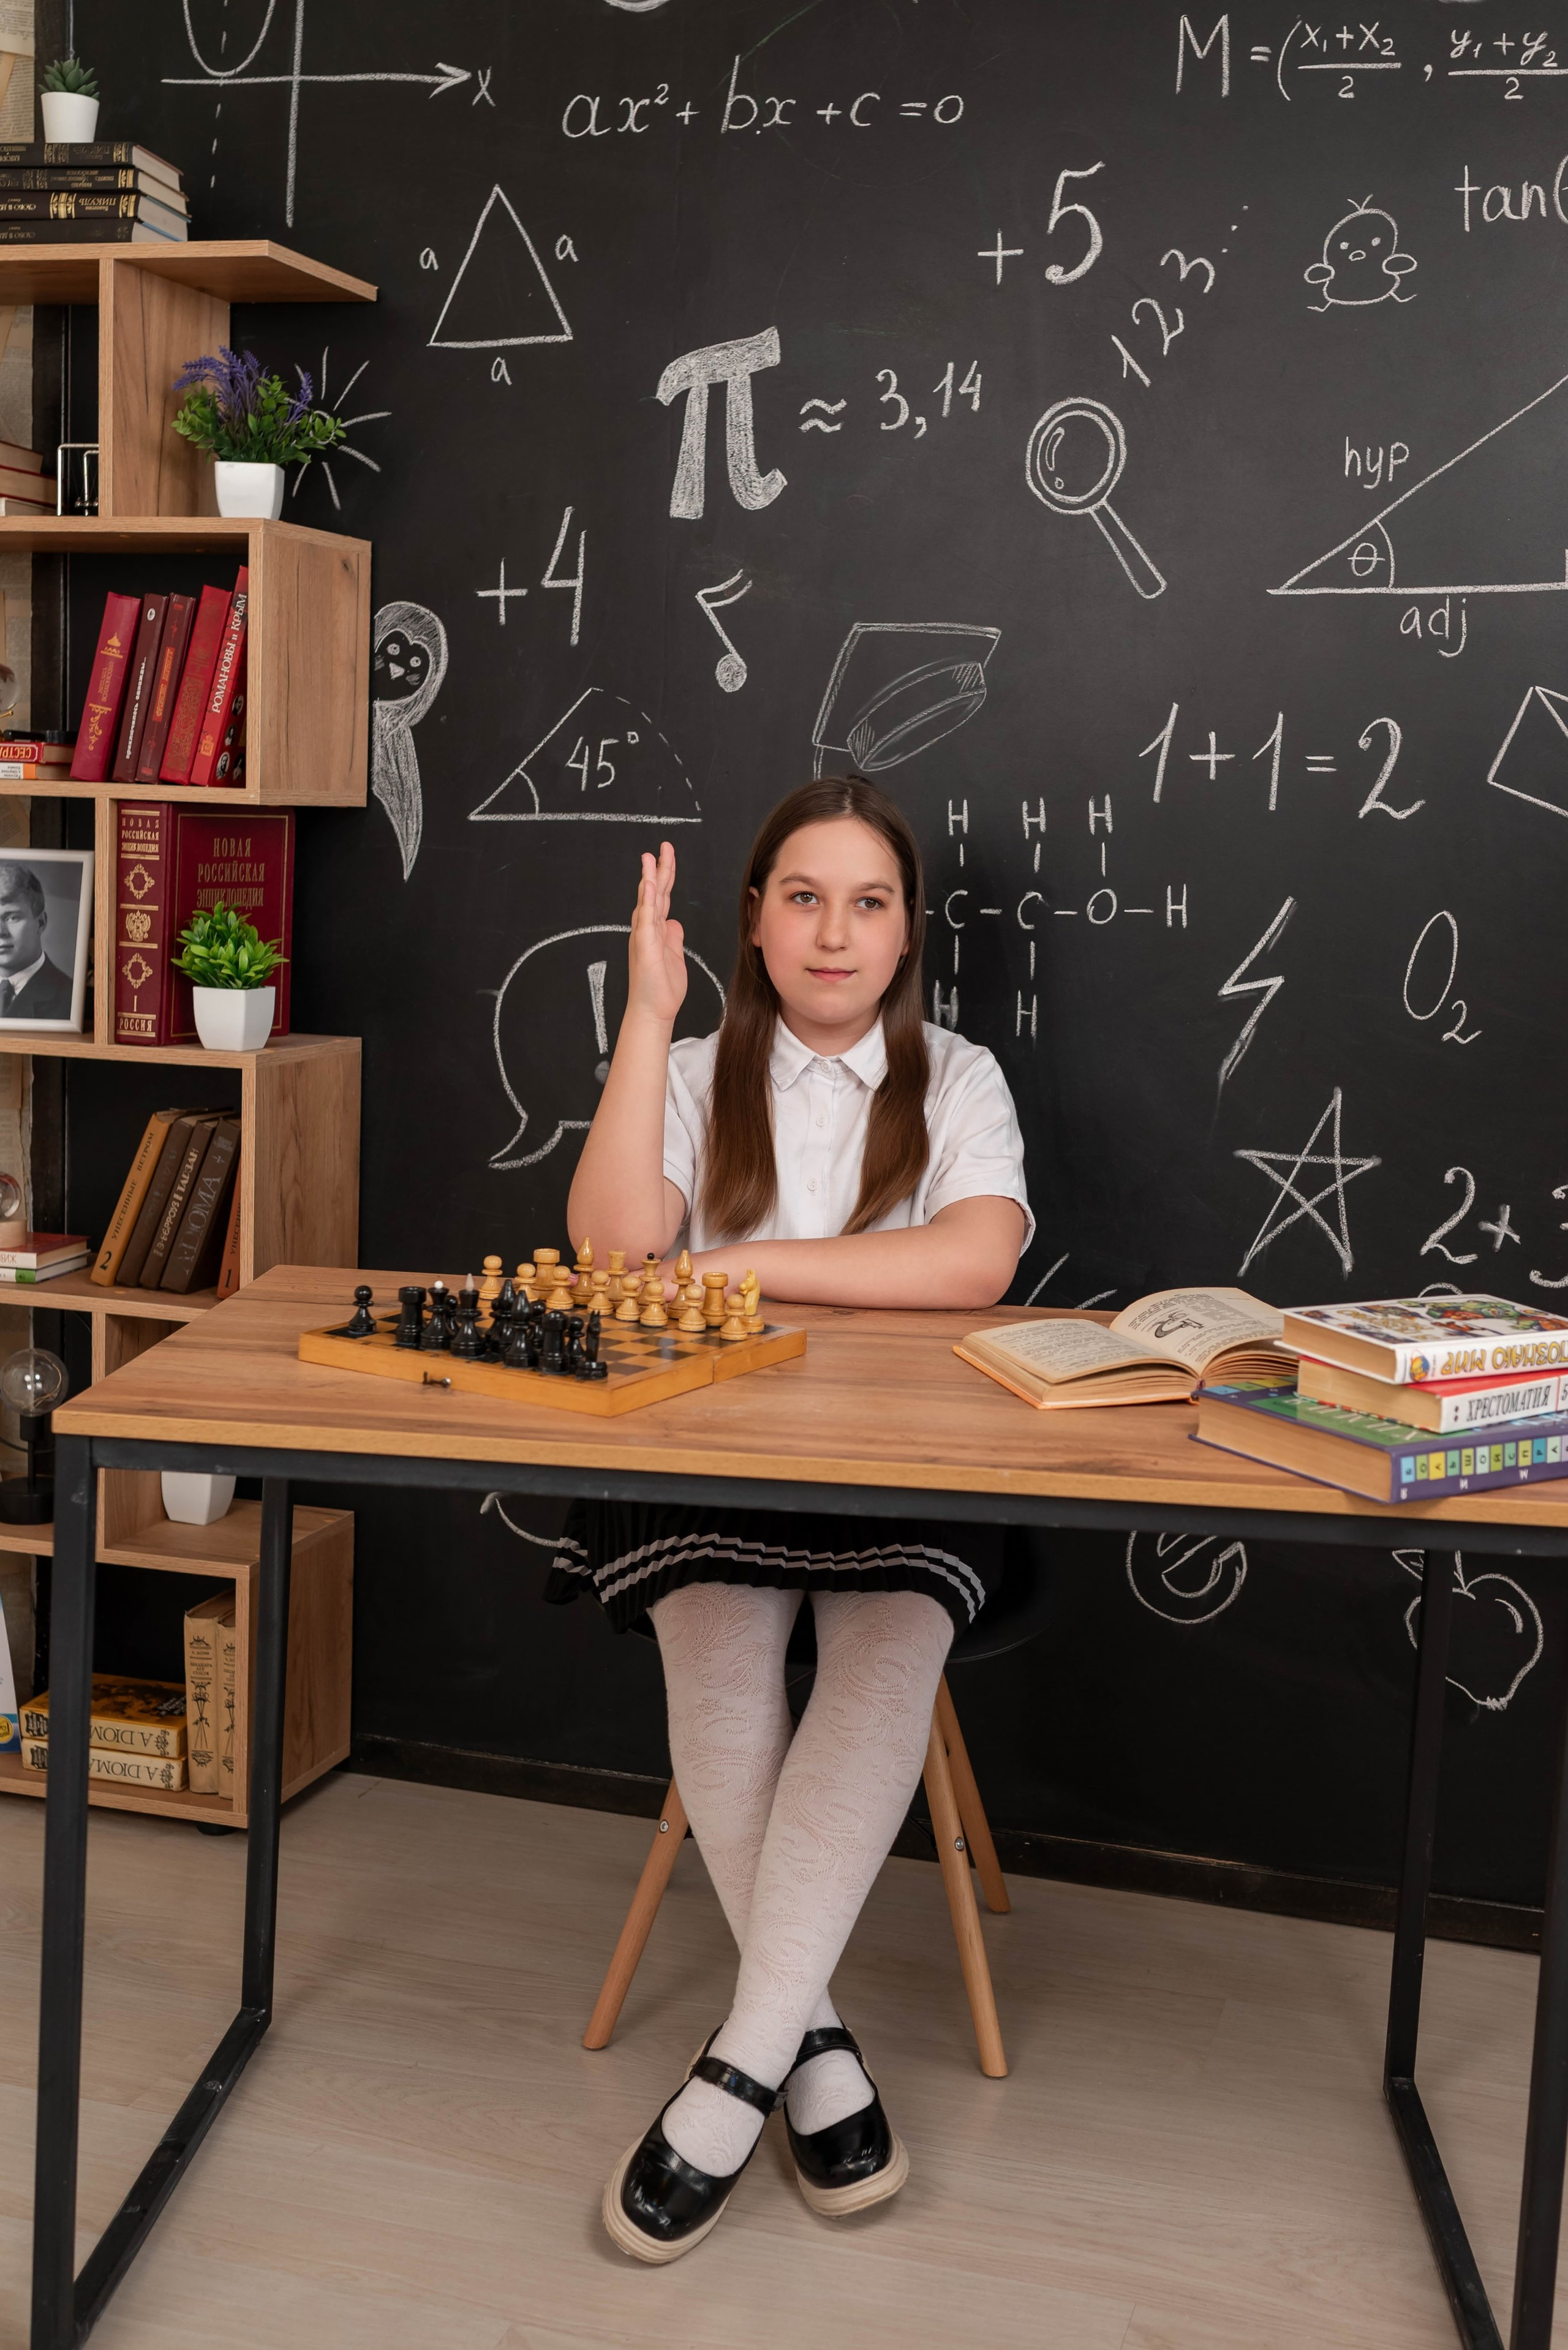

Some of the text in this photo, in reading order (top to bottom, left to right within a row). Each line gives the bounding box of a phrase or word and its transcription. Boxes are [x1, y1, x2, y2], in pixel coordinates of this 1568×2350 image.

[1176, 14, 1229, 97] M
[78, 197, 117, 206] ПИКУЛЬ
[420, 247, 439, 270] a
[555, 235, 579, 262] a
[491, 357, 513, 385] a
[655, 326, 788, 519] π
[1345, 436, 1409, 489] hyp
[1400, 596, 1468, 658] adj
[212, 642, 236, 714] РОМАНОВЫ
[230, 593, 247, 631] КРЫМ
[122, 818, 159, 829] НОВАЯ
[122, 830, 159, 841] РОССИЙСКАЯ
[121, 842, 159, 853] ЭНЦИКЛОПЕДИЯ
[213, 838, 251, 857] НОВАЯ
[197, 861, 265, 883] РОССИЙСКАЯ
[197, 887, 265, 909] ЭНЦИКЛОПЕДИЯ
[119, 1018, 152, 1031] РОССИЯ
[111, 1133, 154, 1240] УНЕСЕННЫЕ ВЕТРОМ
[0, 1254, 17, 1264] ЖИЗ
[99, 1250, 112, 1271] 2
[225, 1268, 232, 1288] 1
[1441, 1349, 1487, 1375] МИР
[1465, 1385, 1551, 1422] ХРЕСТОМАТИЯ
